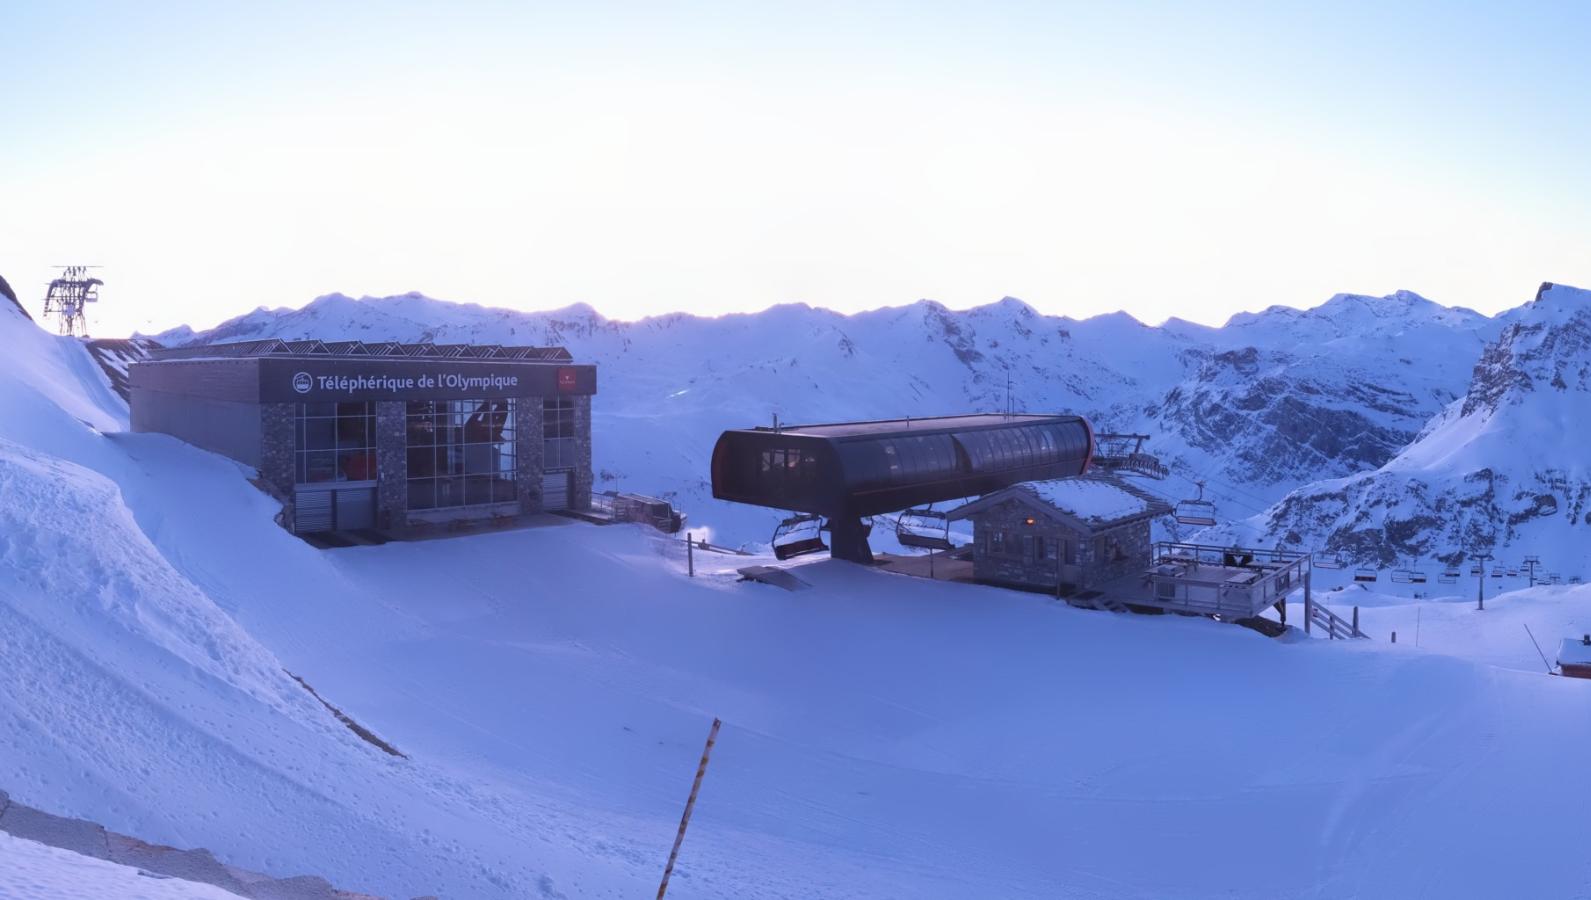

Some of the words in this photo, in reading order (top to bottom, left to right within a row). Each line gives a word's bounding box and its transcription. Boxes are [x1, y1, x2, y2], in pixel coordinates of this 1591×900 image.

[316, 374, 414, 394] Téléphérique
[417, 374, 435, 388] de
[437, 373, 518, 391] l'Olympique
